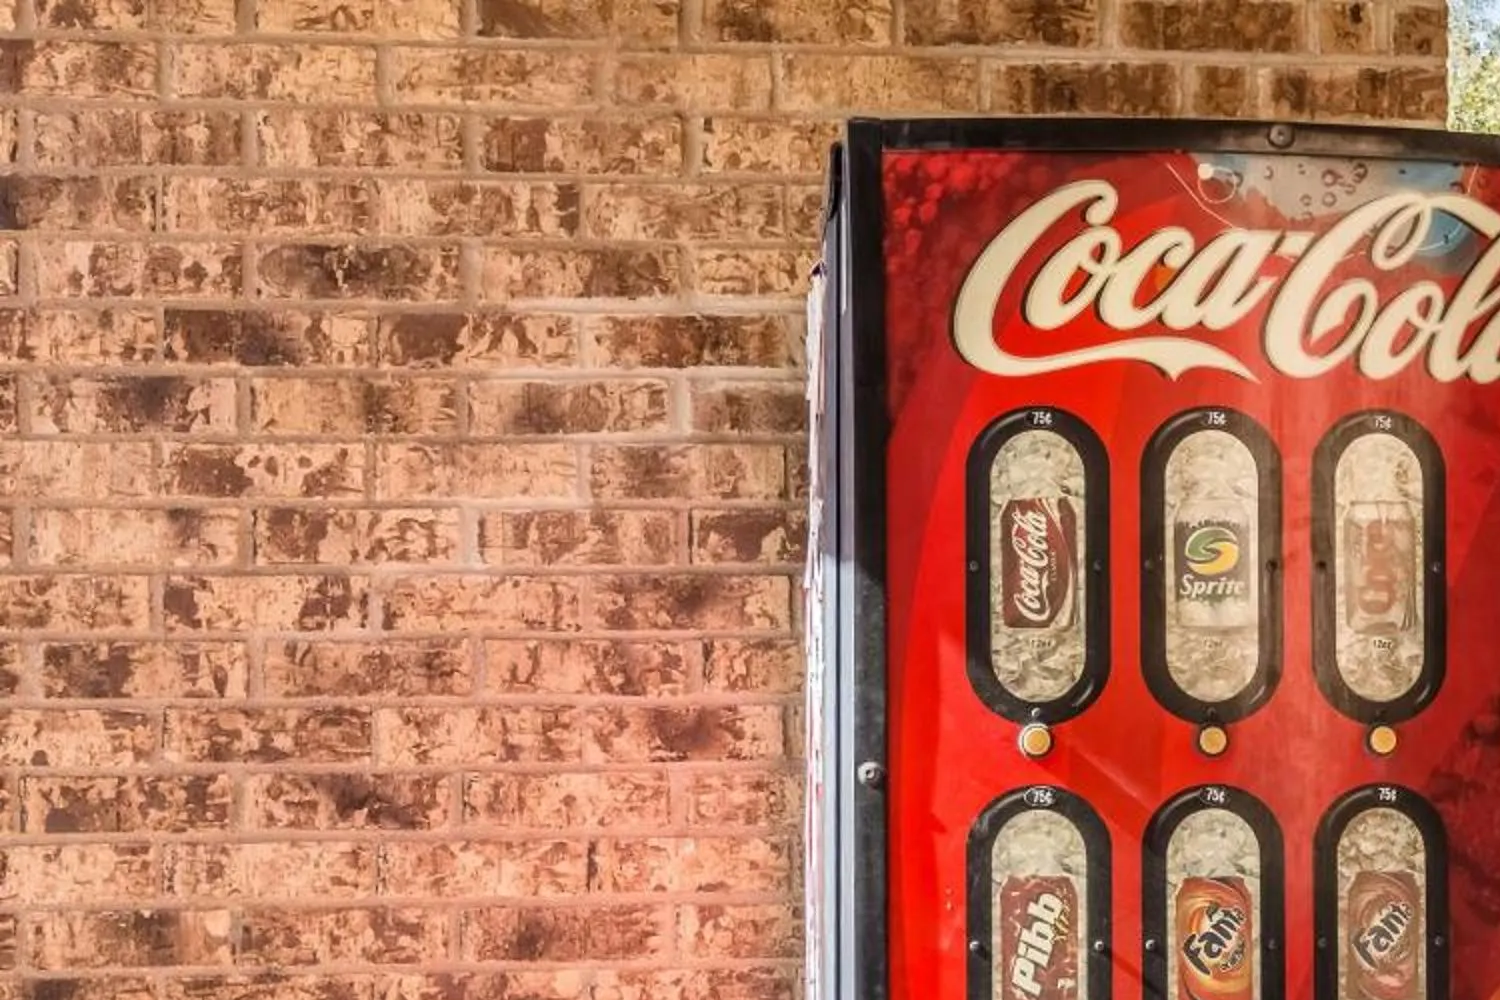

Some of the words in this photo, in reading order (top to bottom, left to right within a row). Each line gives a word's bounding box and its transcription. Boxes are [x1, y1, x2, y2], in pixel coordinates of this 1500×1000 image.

[1031, 411, 1053, 425] 75¢
[1205, 411, 1227, 425] 75¢
[1011, 508, 1049, 622] Coca-Cola
[1179, 574, 1246, 598] Sprite
[1033, 789, 1053, 804] 75¢
[1205, 787, 1225, 803] 75¢
[1378, 787, 1397, 801] 75¢
[1012, 893, 1063, 996] Pibb
[1184, 906, 1246, 976] Fanta
